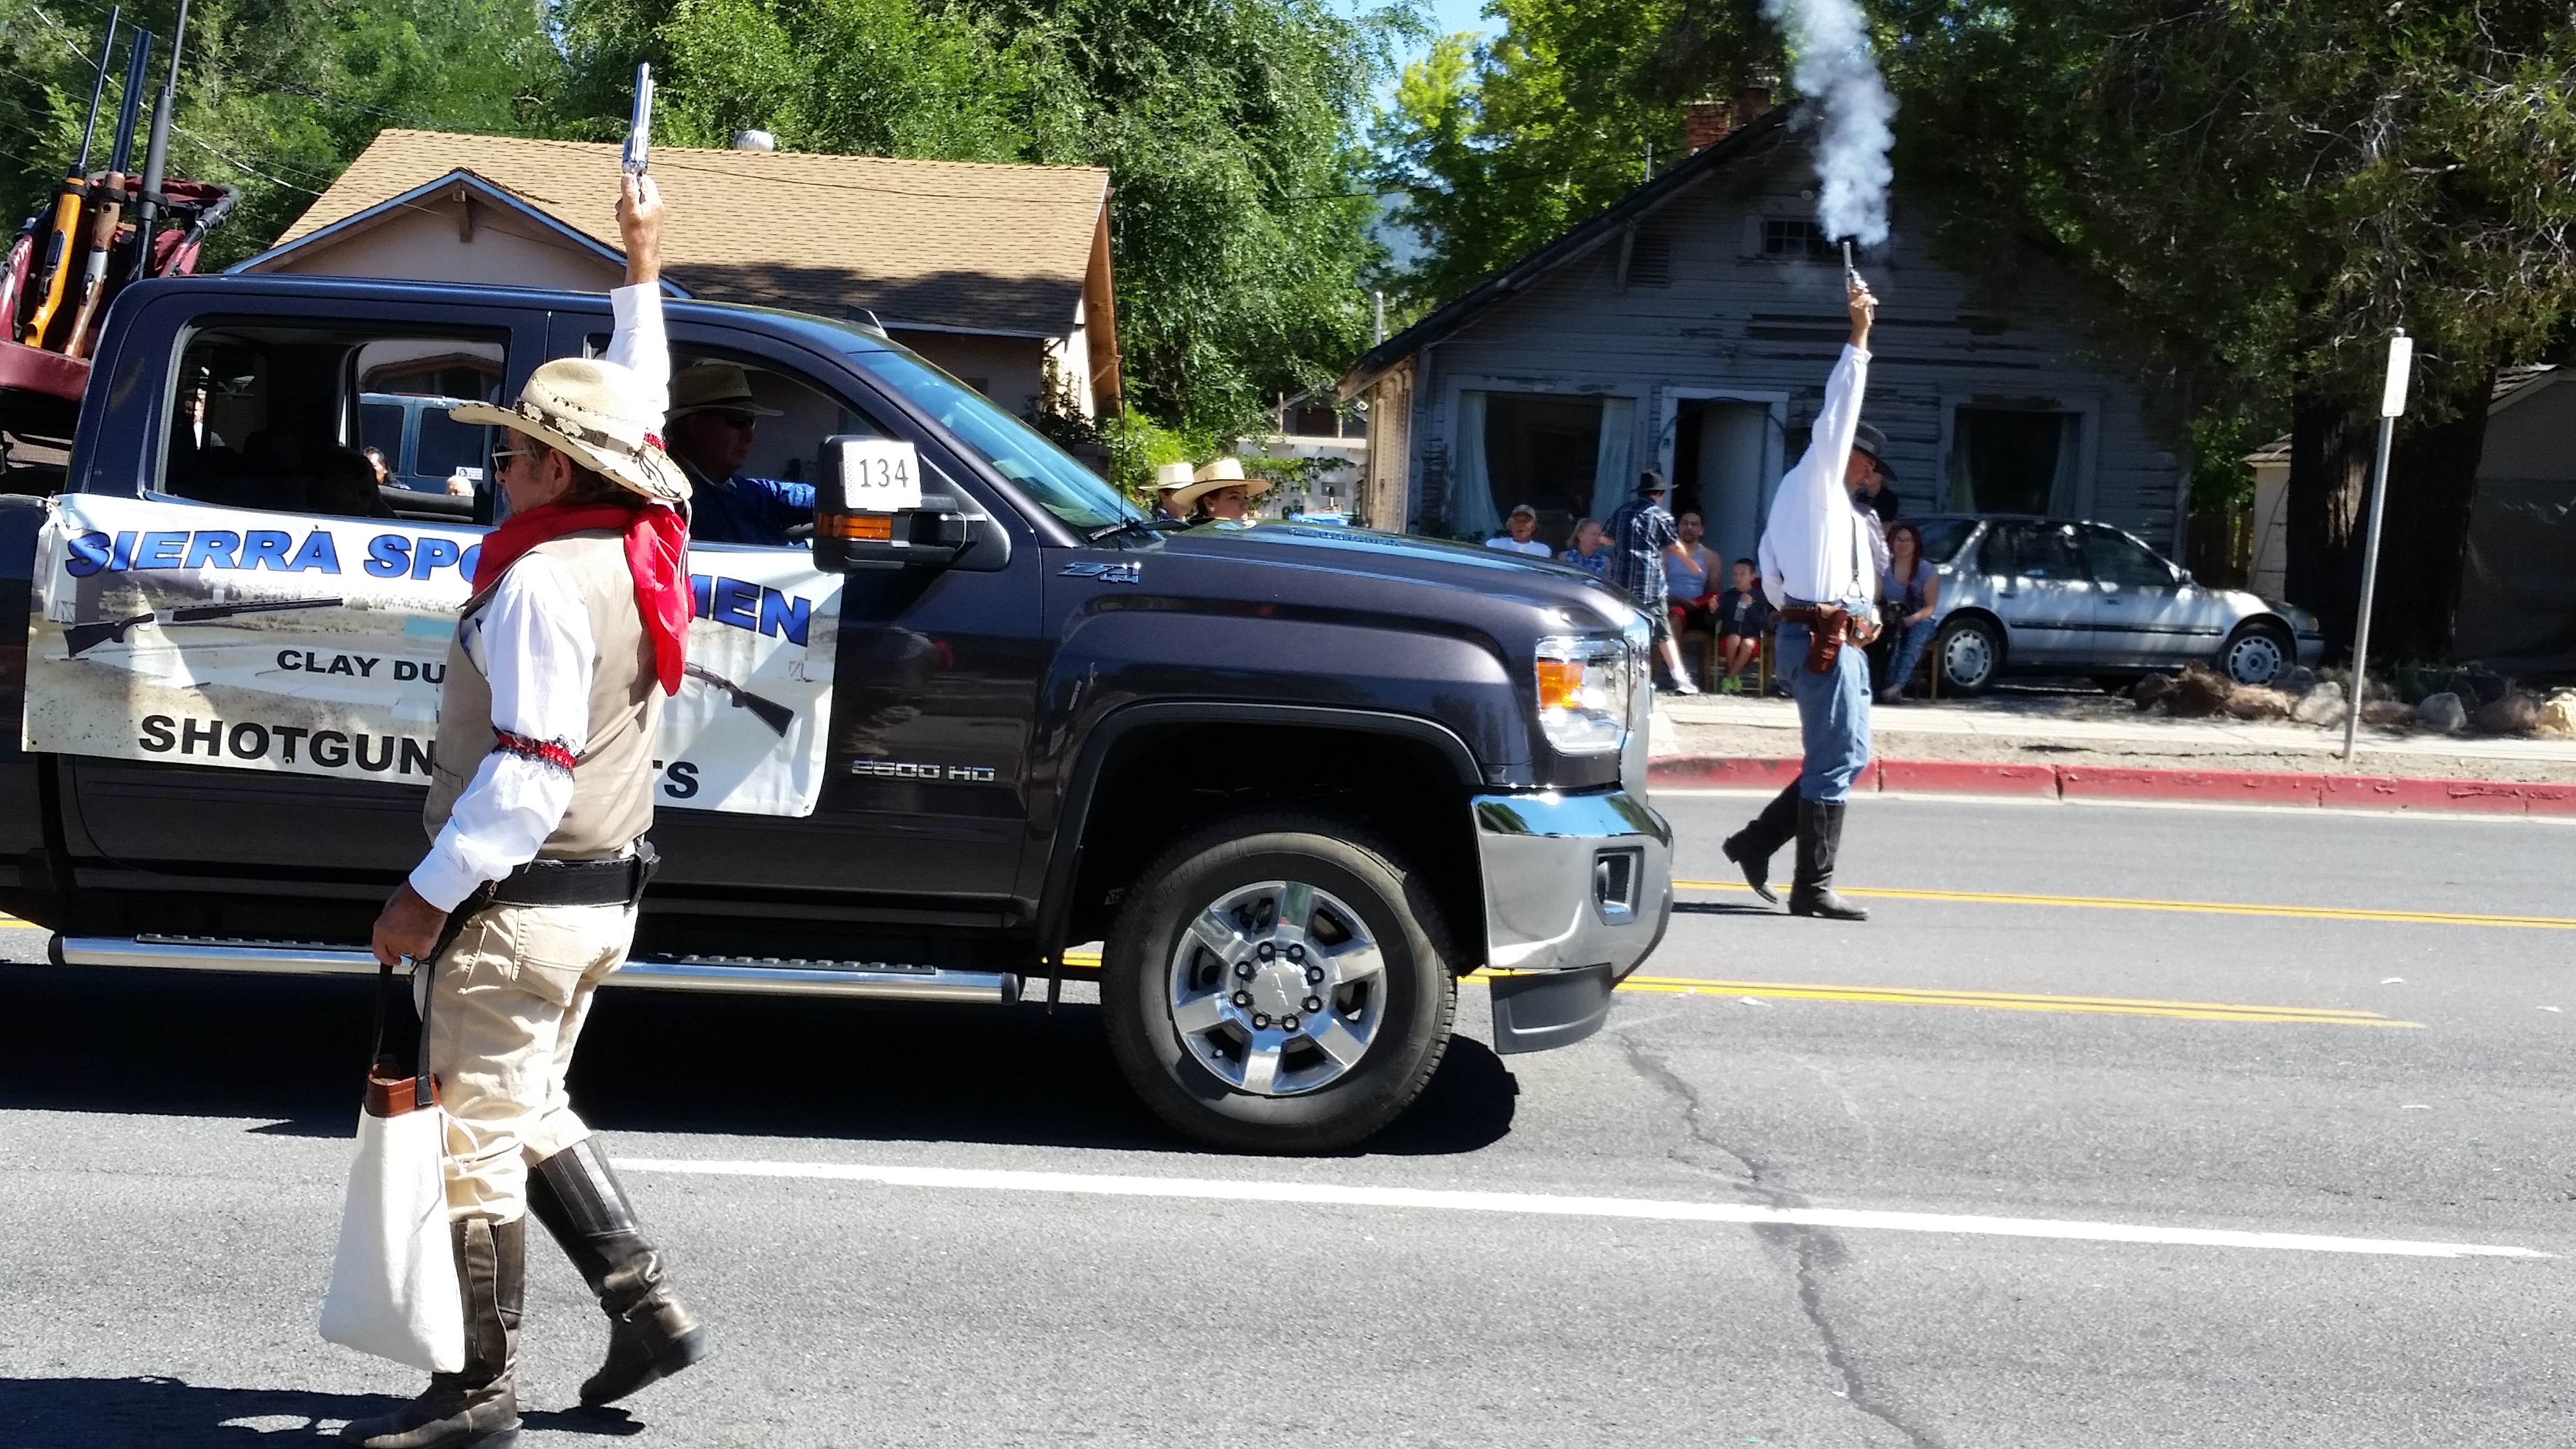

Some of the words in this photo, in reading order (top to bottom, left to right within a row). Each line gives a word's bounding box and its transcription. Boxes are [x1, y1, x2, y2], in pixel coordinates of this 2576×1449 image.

[859, 458, 909, 488] 134
[65, 530, 341, 578] SIERRA
[276, 650, 380, 677] CLAY
[139, 715, 435, 776] SHOTGUN
[852, 760, 940, 779] 2500
[949, 765, 995, 782] HD
